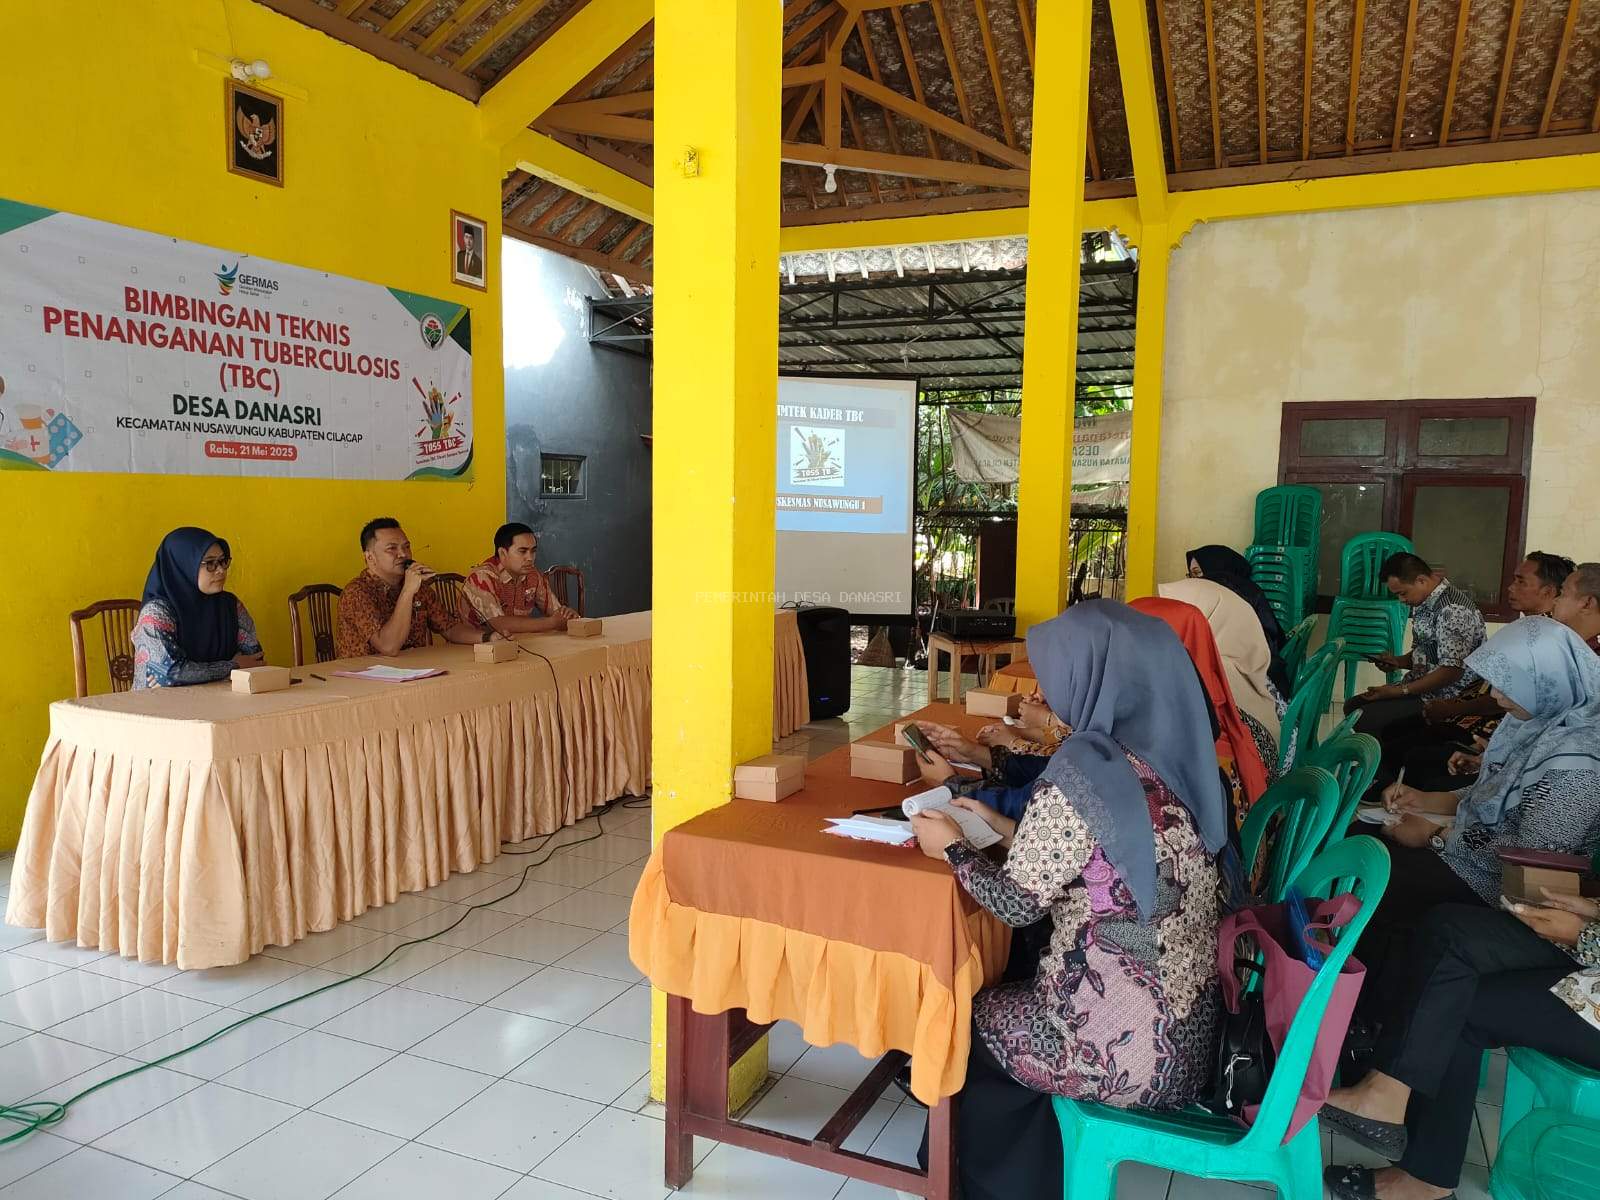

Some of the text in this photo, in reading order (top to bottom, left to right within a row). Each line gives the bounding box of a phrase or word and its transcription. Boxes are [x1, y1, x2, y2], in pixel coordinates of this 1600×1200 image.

[238, 273, 279, 291] GERMAS
[124, 286, 351, 347] BIMBINGAN TEKNIS
[42, 305, 401, 380] PENANGANAN TUBERCULOSIS
[219, 362, 280, 398] (TBC)
[173, 393, 322, 426] DESA DANASRI
[776, 404, 864, 423] IMTEK KADER TBC
[116, 416, 363, 444] KECAMATAN NUSAWUNGU KABUPATEN CILACAP
[209, 443, 294, 457] Rabu, 21 Mei 2025
[424, 438, 457, 455] TOSS TBC
[776, 496, 811, 508] SKESMAS
